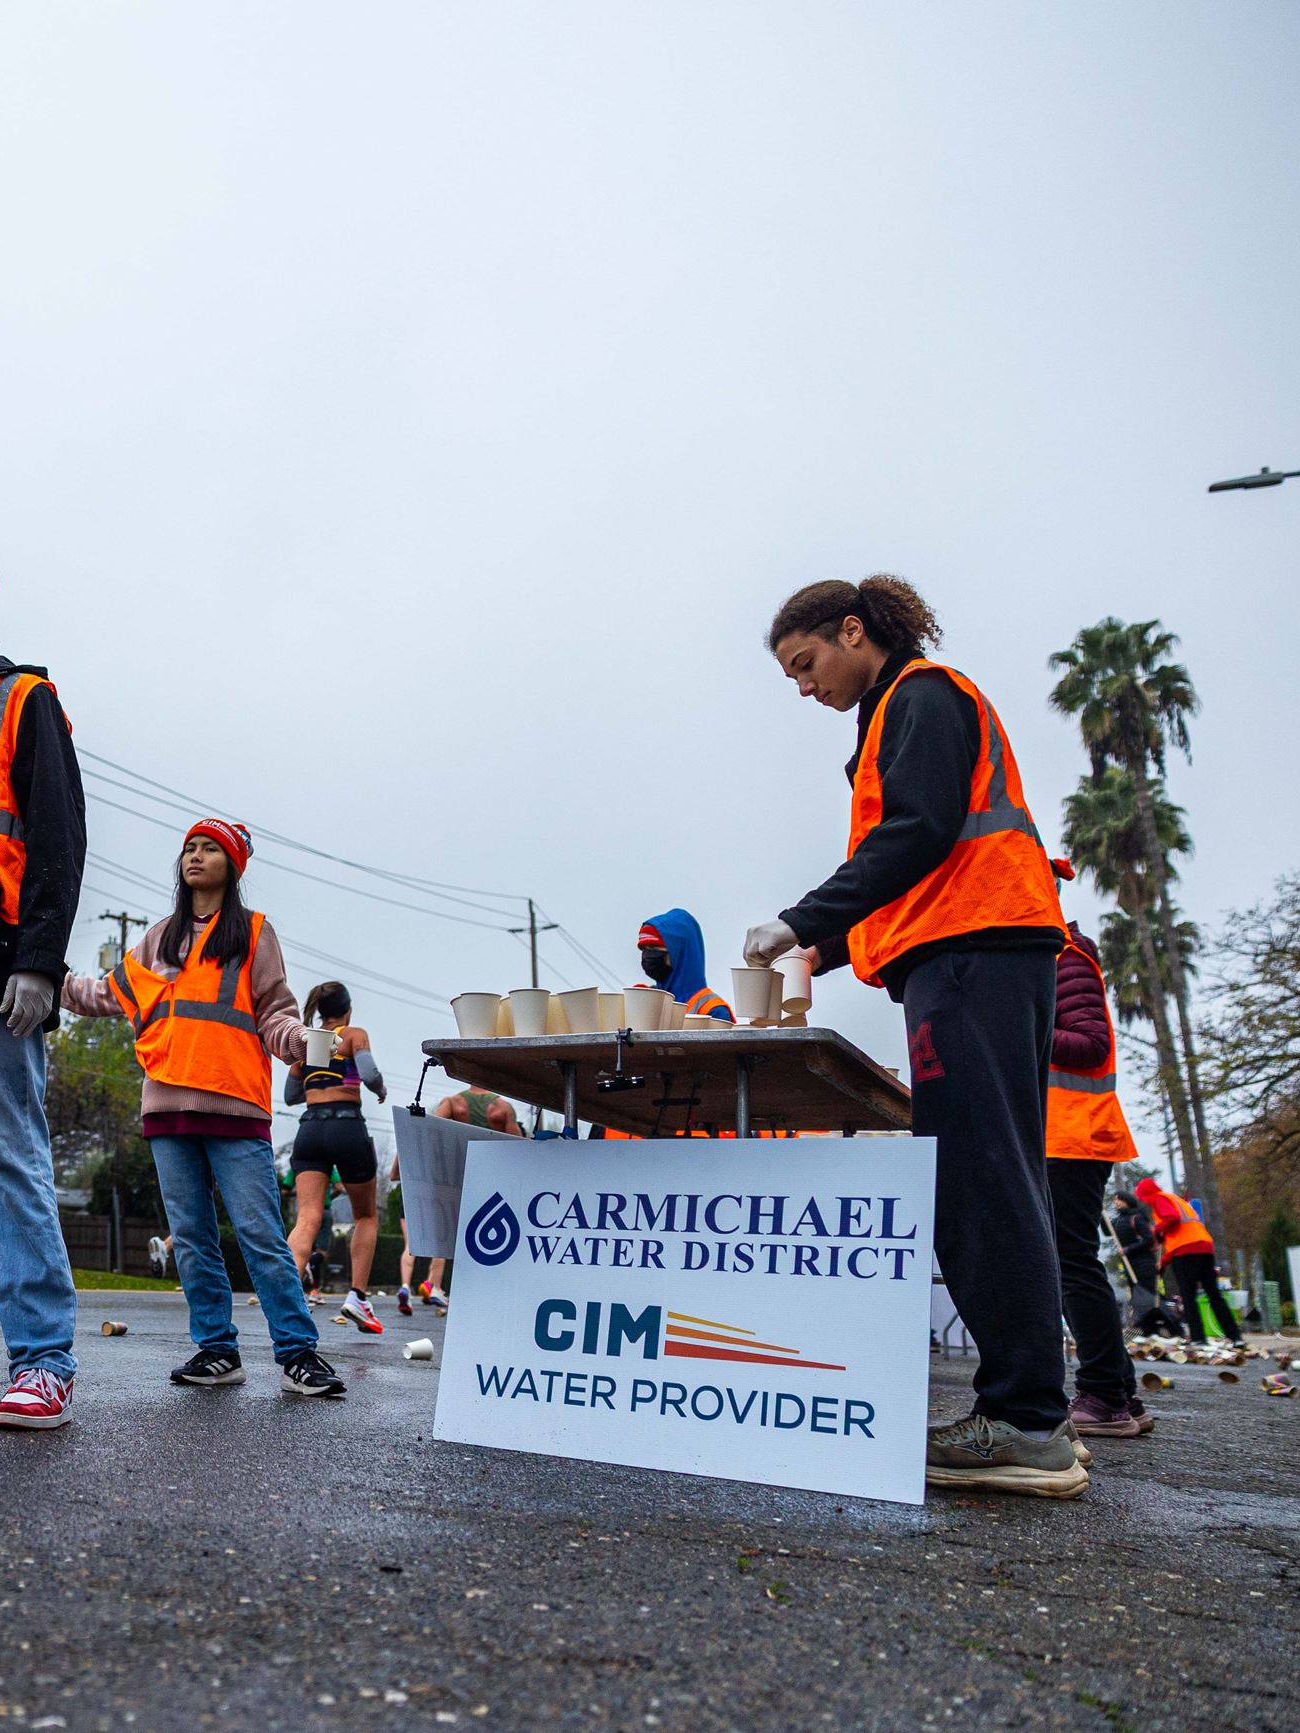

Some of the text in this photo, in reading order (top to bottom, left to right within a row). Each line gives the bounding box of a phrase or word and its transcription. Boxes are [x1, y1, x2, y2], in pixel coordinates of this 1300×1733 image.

[527, 1191, 917, 1239] CARMICHAEL
[526, 1235, 915, 1280] WATER DISTRICT
[534, 1298, 662, 1360] CIM
[475, 1363, 876, 1439] WATER PROVIDER
